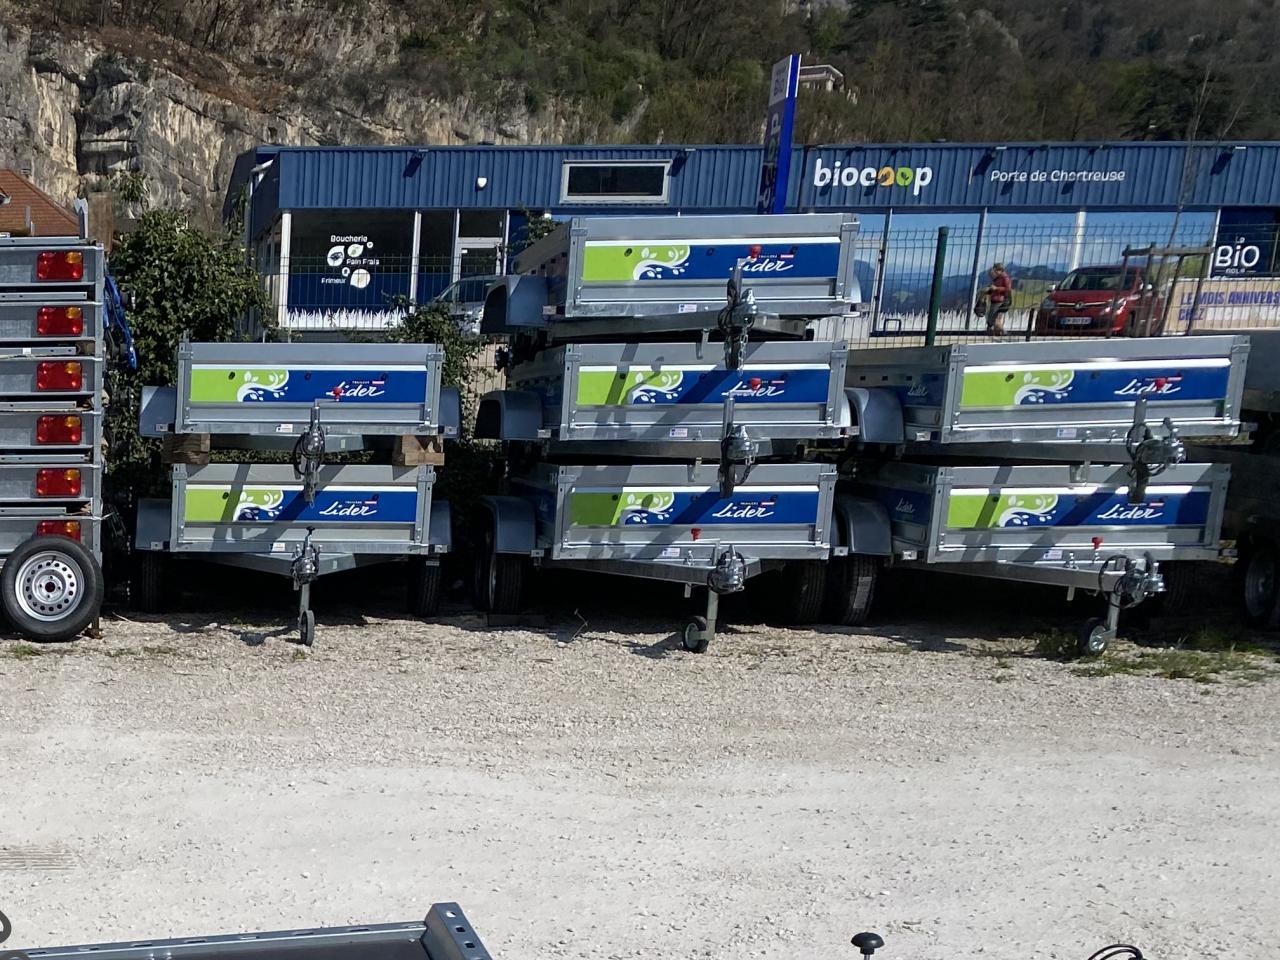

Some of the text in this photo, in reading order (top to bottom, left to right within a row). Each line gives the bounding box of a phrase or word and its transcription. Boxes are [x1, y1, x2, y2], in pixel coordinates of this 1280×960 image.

[813, 158, 1126, 196] biocoop Porte de Chartreuse
[330, 235, 368, 243] Boucherie
[318, 500, 378, 516] Lider
[711, 502, 775, 518] Lider
[1096, 503, 1164, 519] Lider
